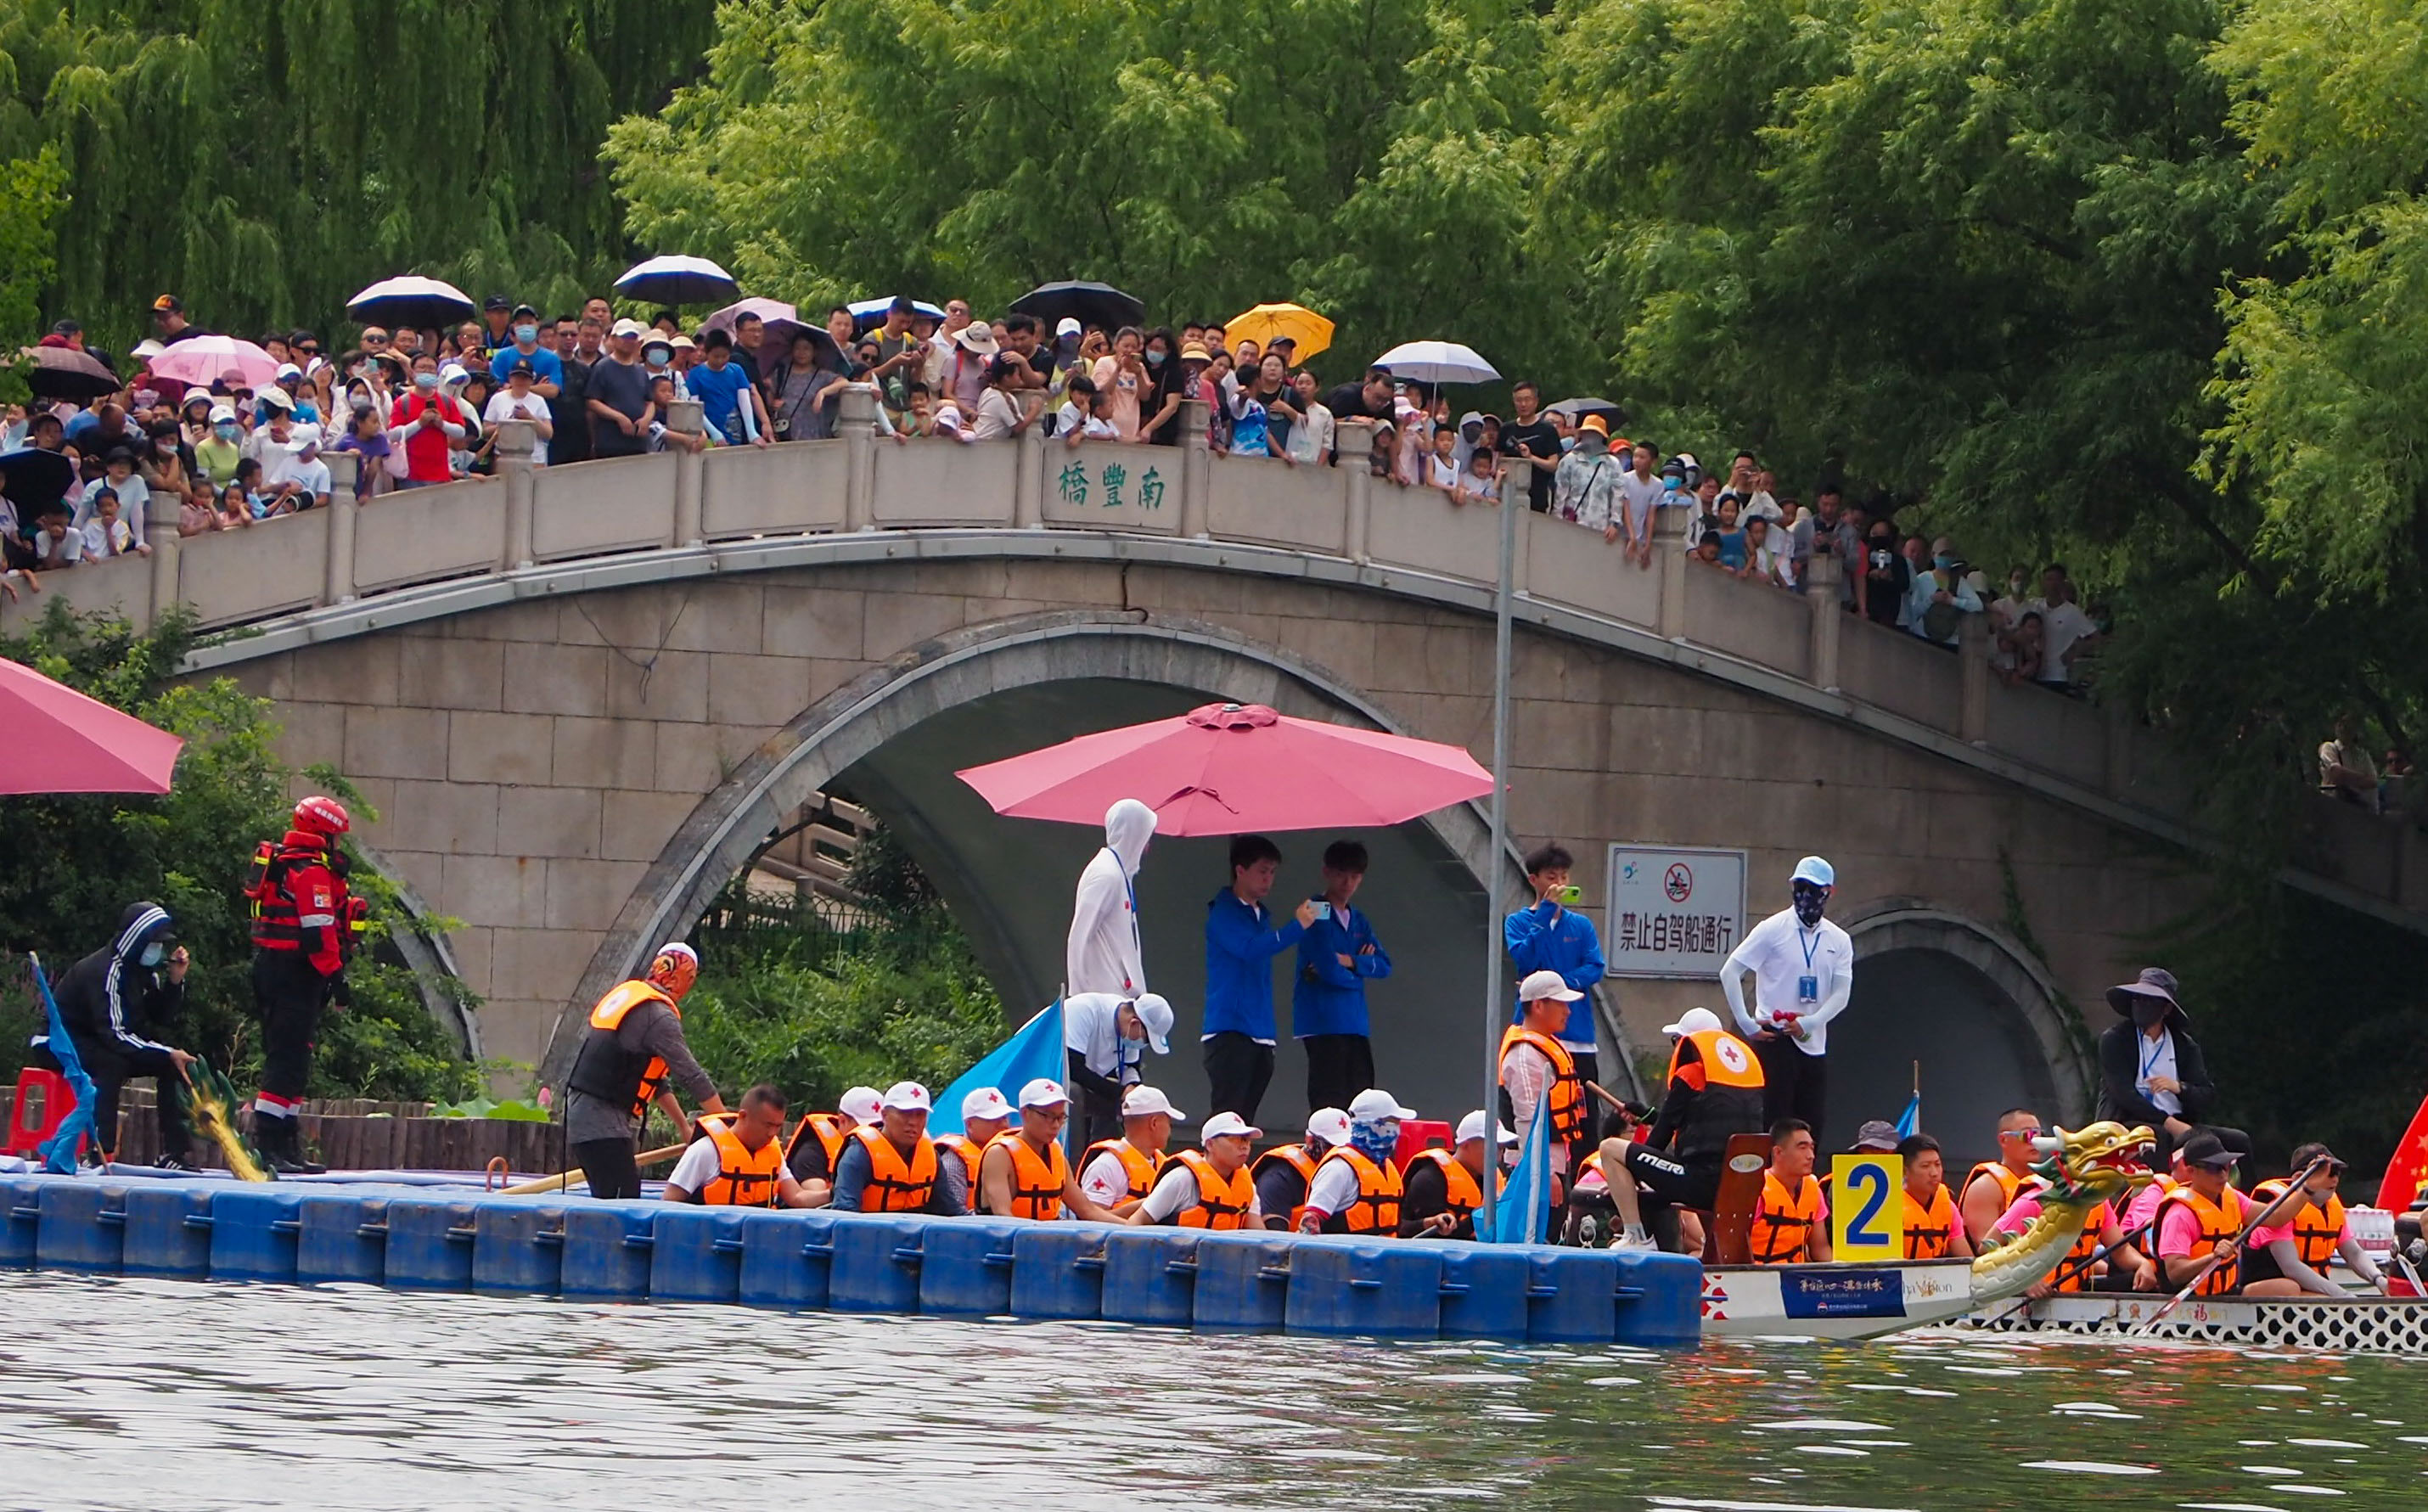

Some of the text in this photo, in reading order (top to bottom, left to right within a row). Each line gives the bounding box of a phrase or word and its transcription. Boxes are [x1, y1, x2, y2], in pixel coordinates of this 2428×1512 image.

[1621, 912, 1732, 954] 禁止自驾船通行
[1846, 1162, 1889, 1245] 2
